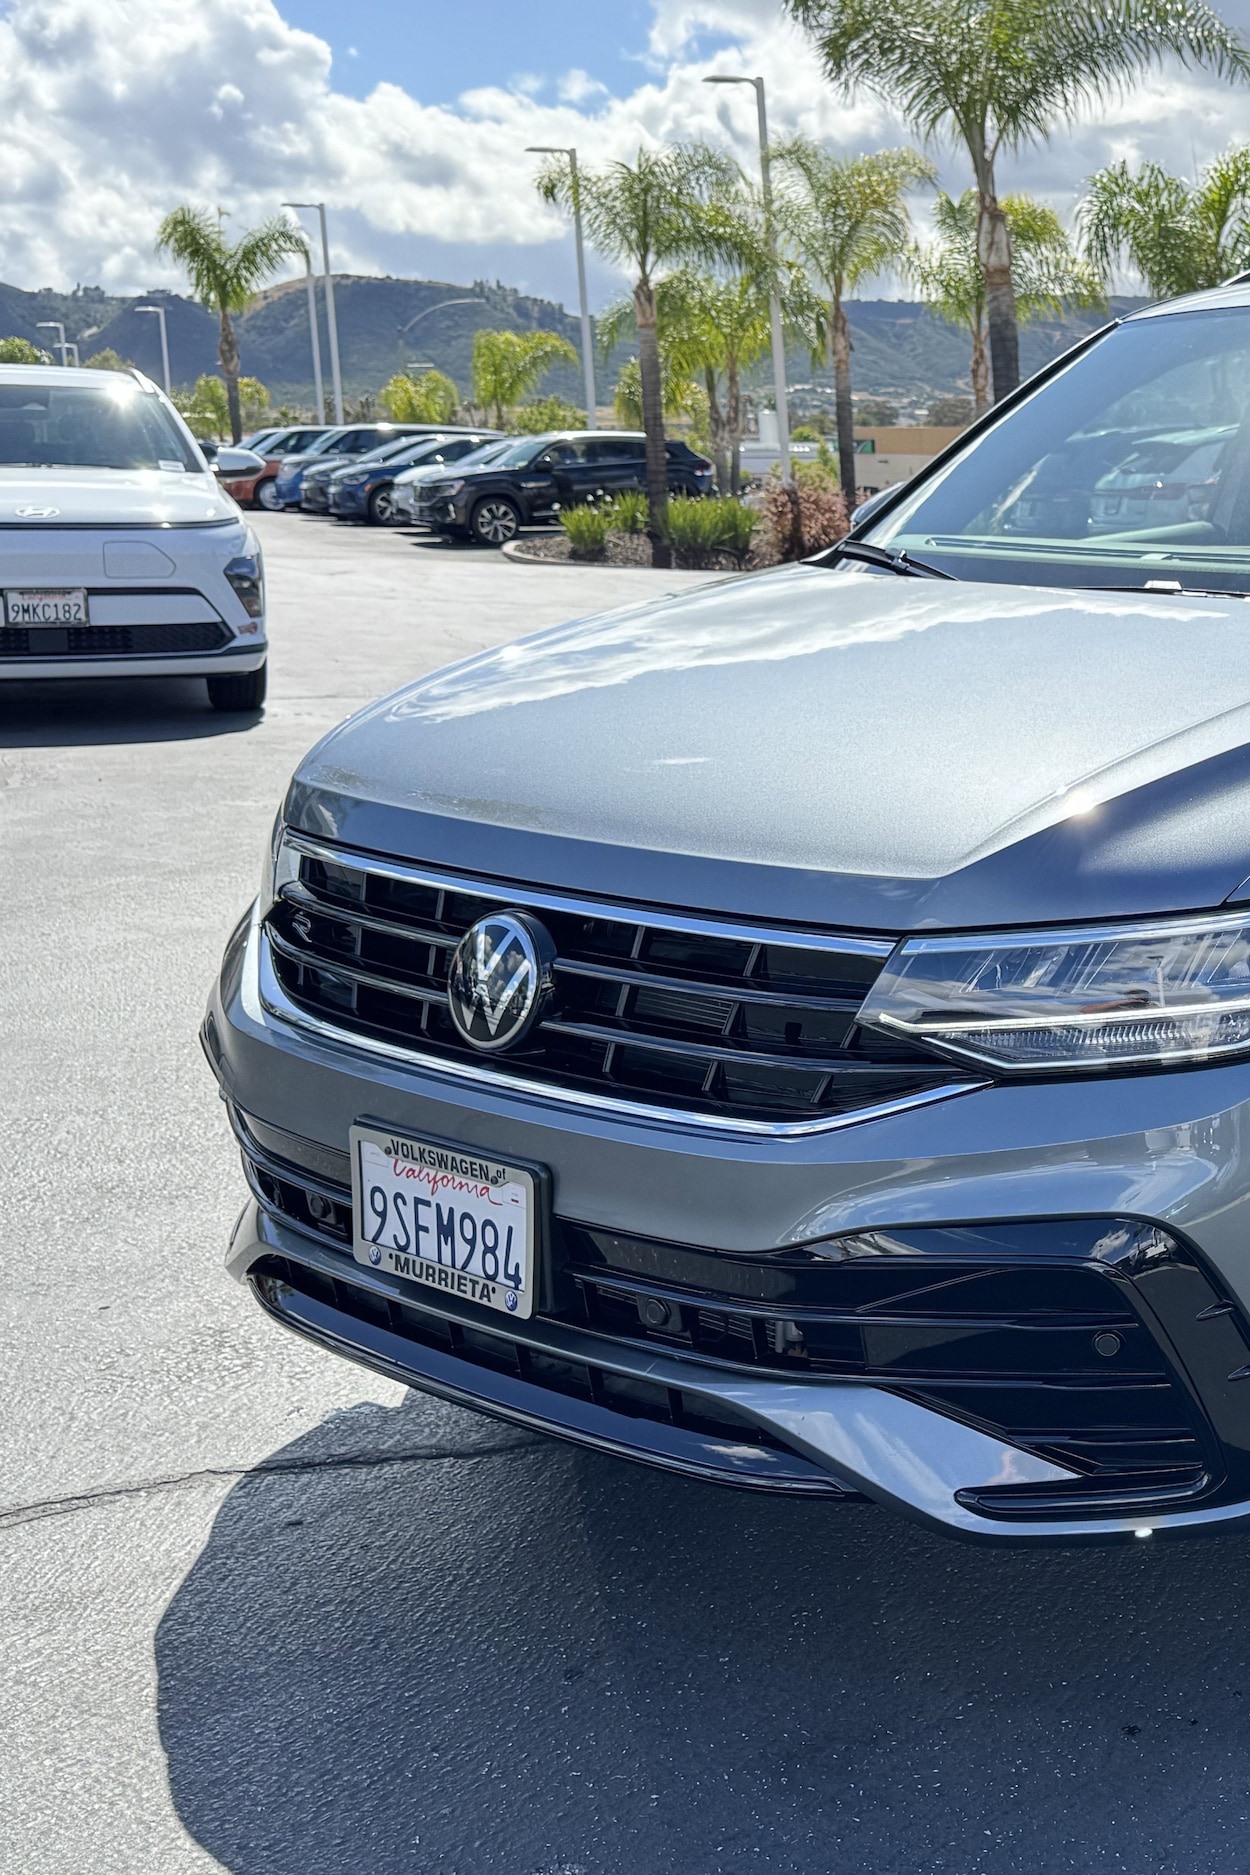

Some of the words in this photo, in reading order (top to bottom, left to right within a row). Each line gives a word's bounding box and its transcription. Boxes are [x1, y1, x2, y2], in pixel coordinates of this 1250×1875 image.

[11, 603, 82, 621] 9MKC182
[391, 1139, 490, 1182] VOLKSWAGEN
[497, 1167, 506, 1180] of
[393, 1159, 503, 1206] California
[370, 1186, 522, 1291] 9SFM984
[394, 1257, 492, 1303] MURRIETA
